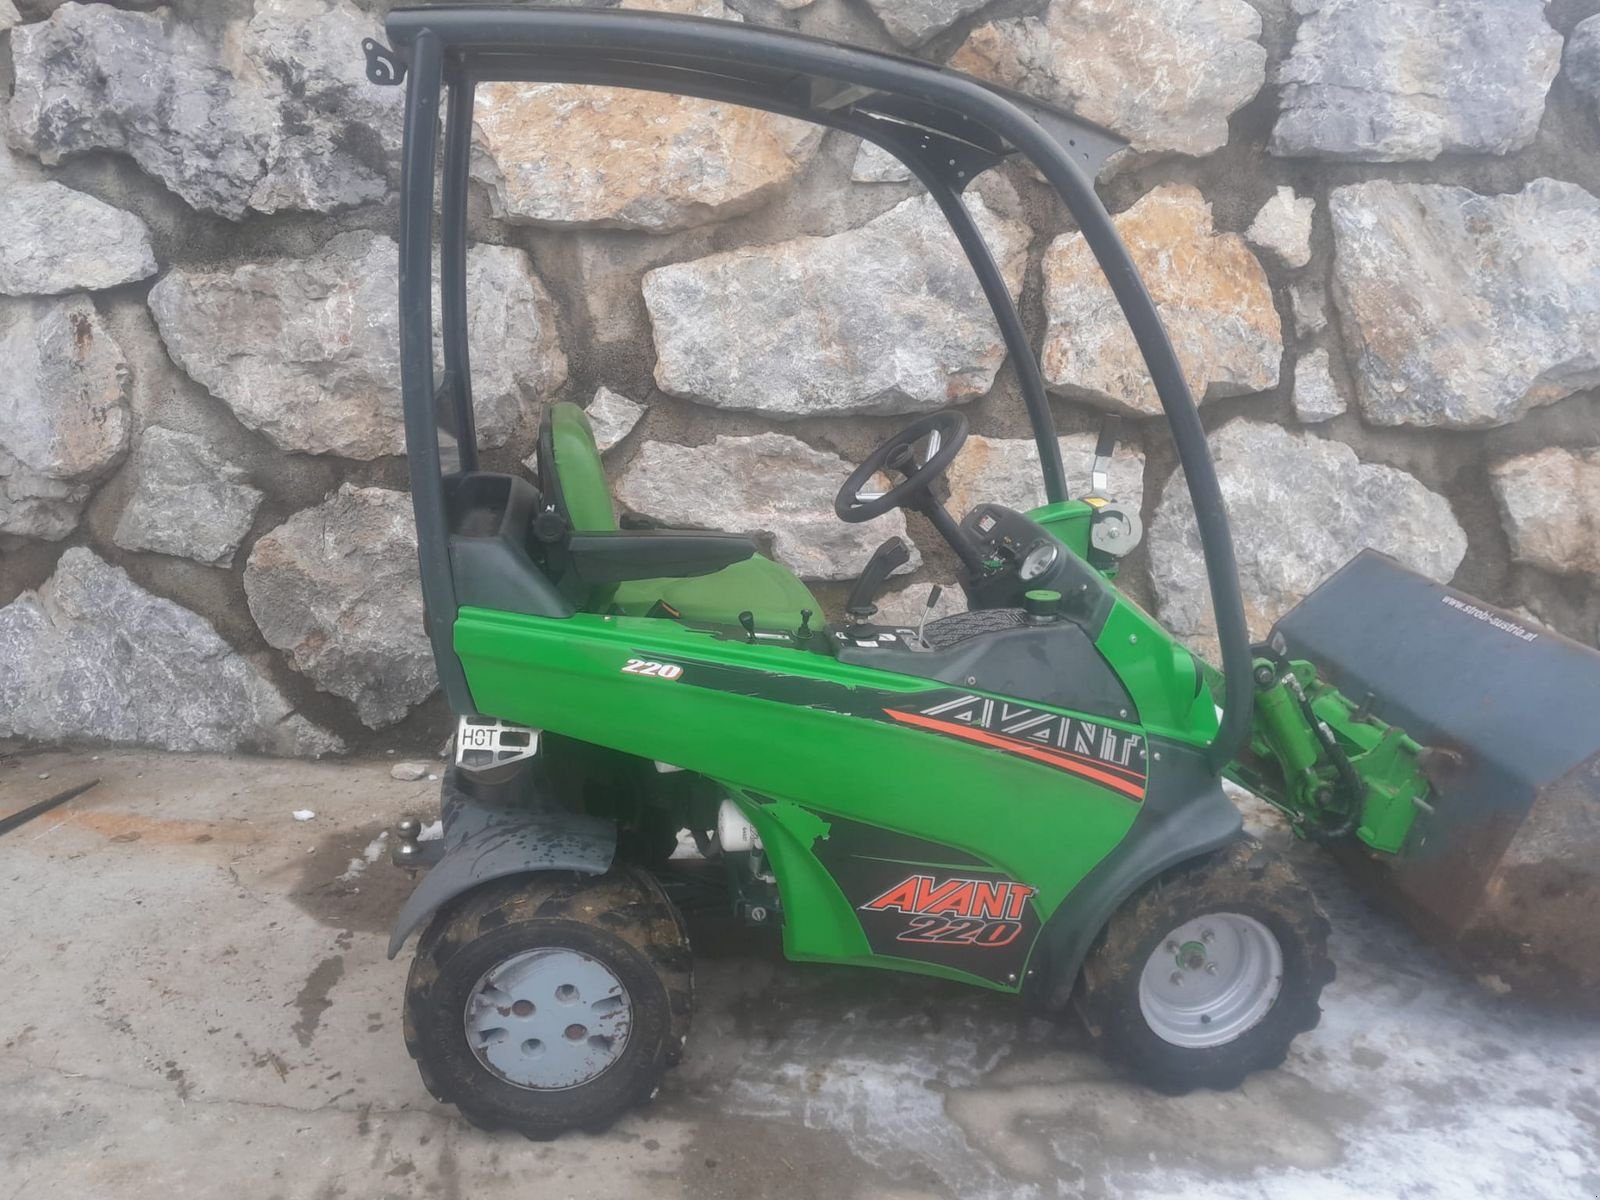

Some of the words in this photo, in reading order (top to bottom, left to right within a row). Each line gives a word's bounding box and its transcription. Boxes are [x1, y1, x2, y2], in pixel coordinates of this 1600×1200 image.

[620, 658, 684, 681] 220
[462, 728, 498, 747] HOT
[919, 695, 1142, 766] AVANT
[856, 874, 1036, 920] AVANT
[896, 915, 1023, 949] 220
